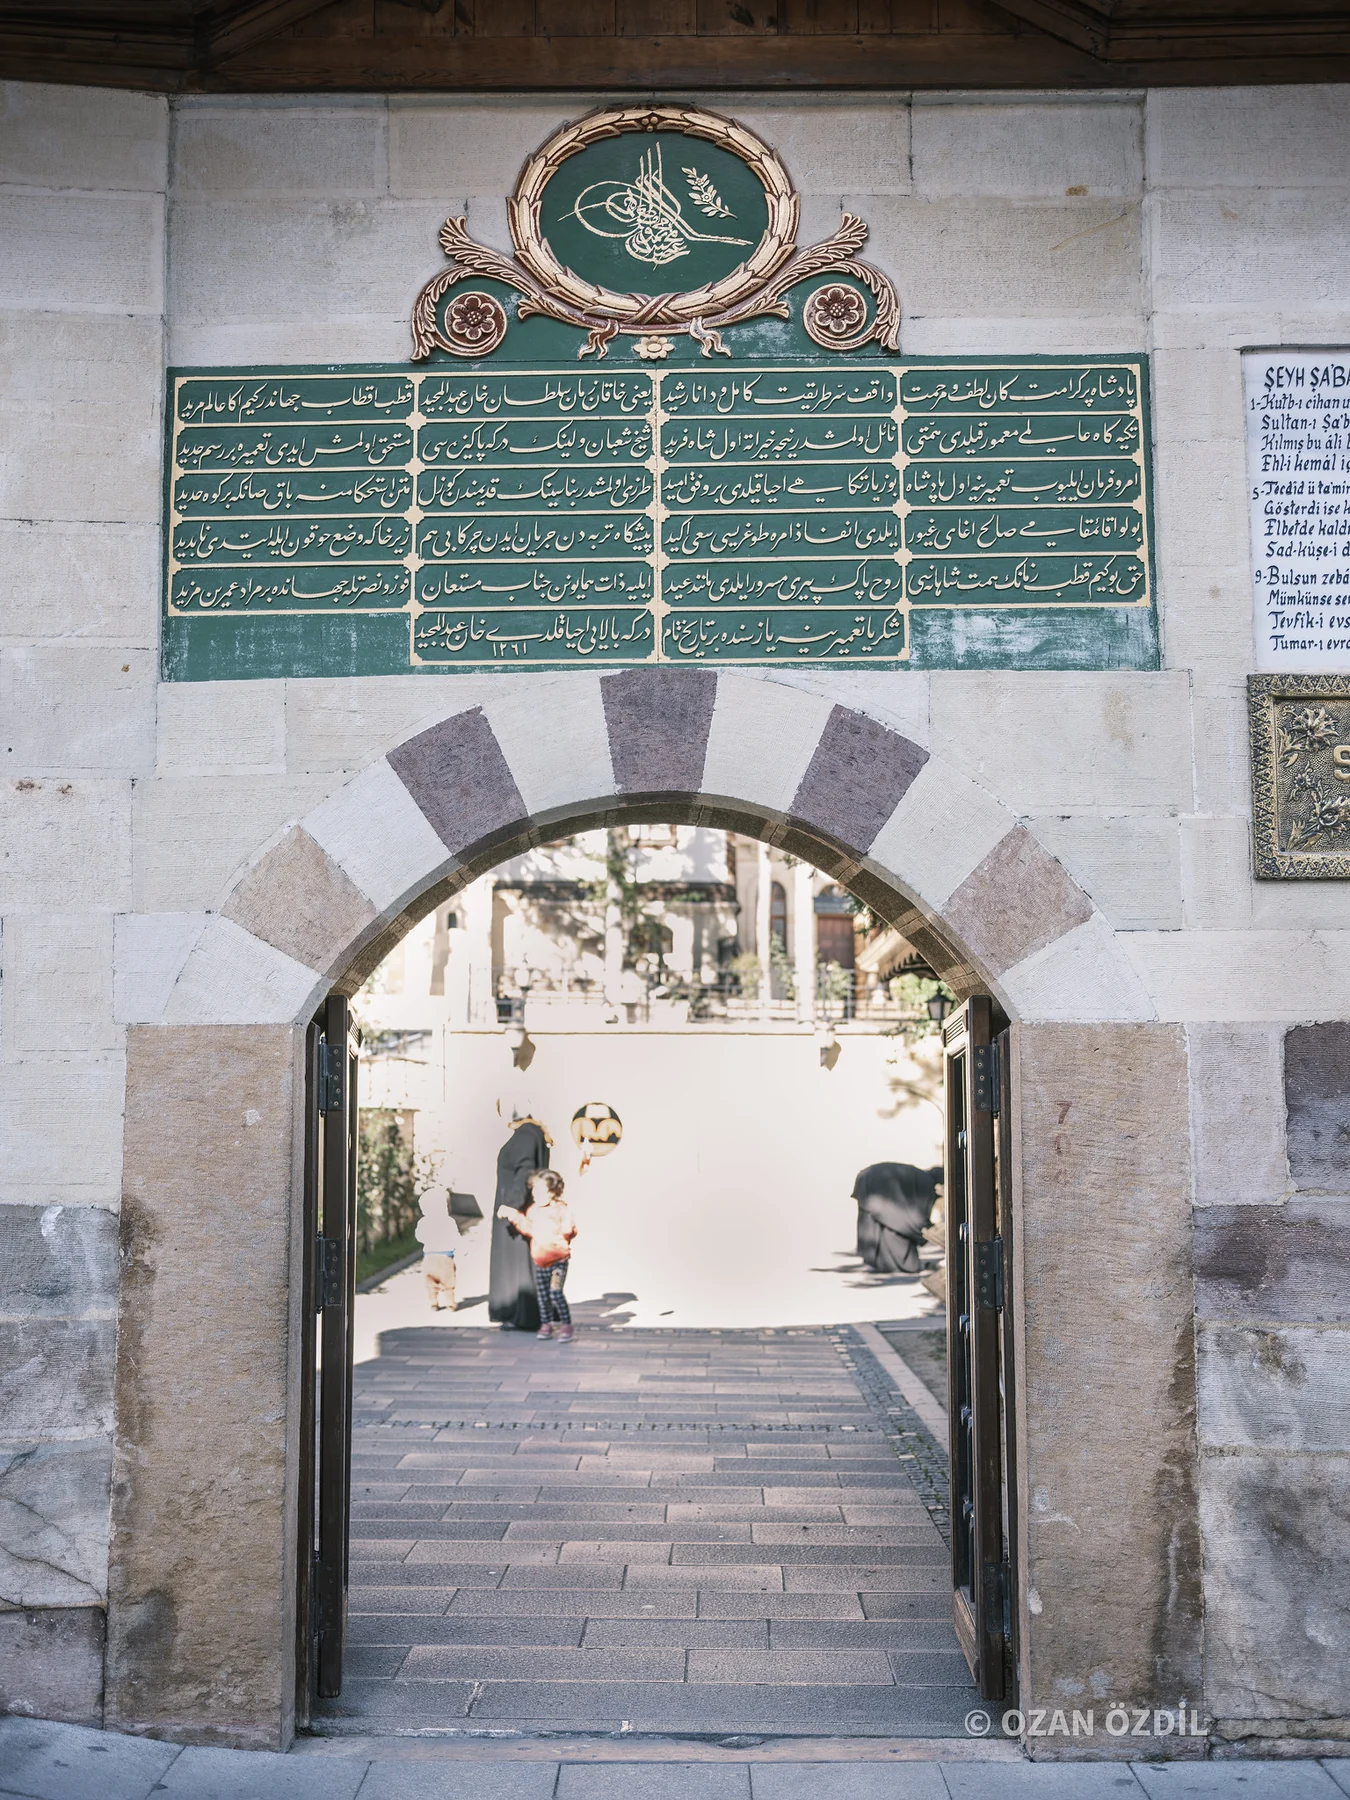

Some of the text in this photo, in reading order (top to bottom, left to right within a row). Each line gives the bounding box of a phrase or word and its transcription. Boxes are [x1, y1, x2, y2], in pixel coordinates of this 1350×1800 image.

[1264, 366, 1305, 392] ŞEYH
[1306, 393, 1340, 410] cihan
[1260, 413, 1316, 430] Sultan-ı
[1261, 433, 1304, 453] Kılmış
[1307, 433, 1321, 450] bu
[1308, 481, 1315, 495] ü
[1264, 500, 1320, 516] Gösterdi
[1323, 501, 1341, 515] ise
[1264, 518, 1315, 536] Elbetde
[1267, 589, 1332, 606] Mümkünse
[1268, 610, 1323, 630] Tevfik-i
[1269, 634, 1323, 651] Tumar-ı
